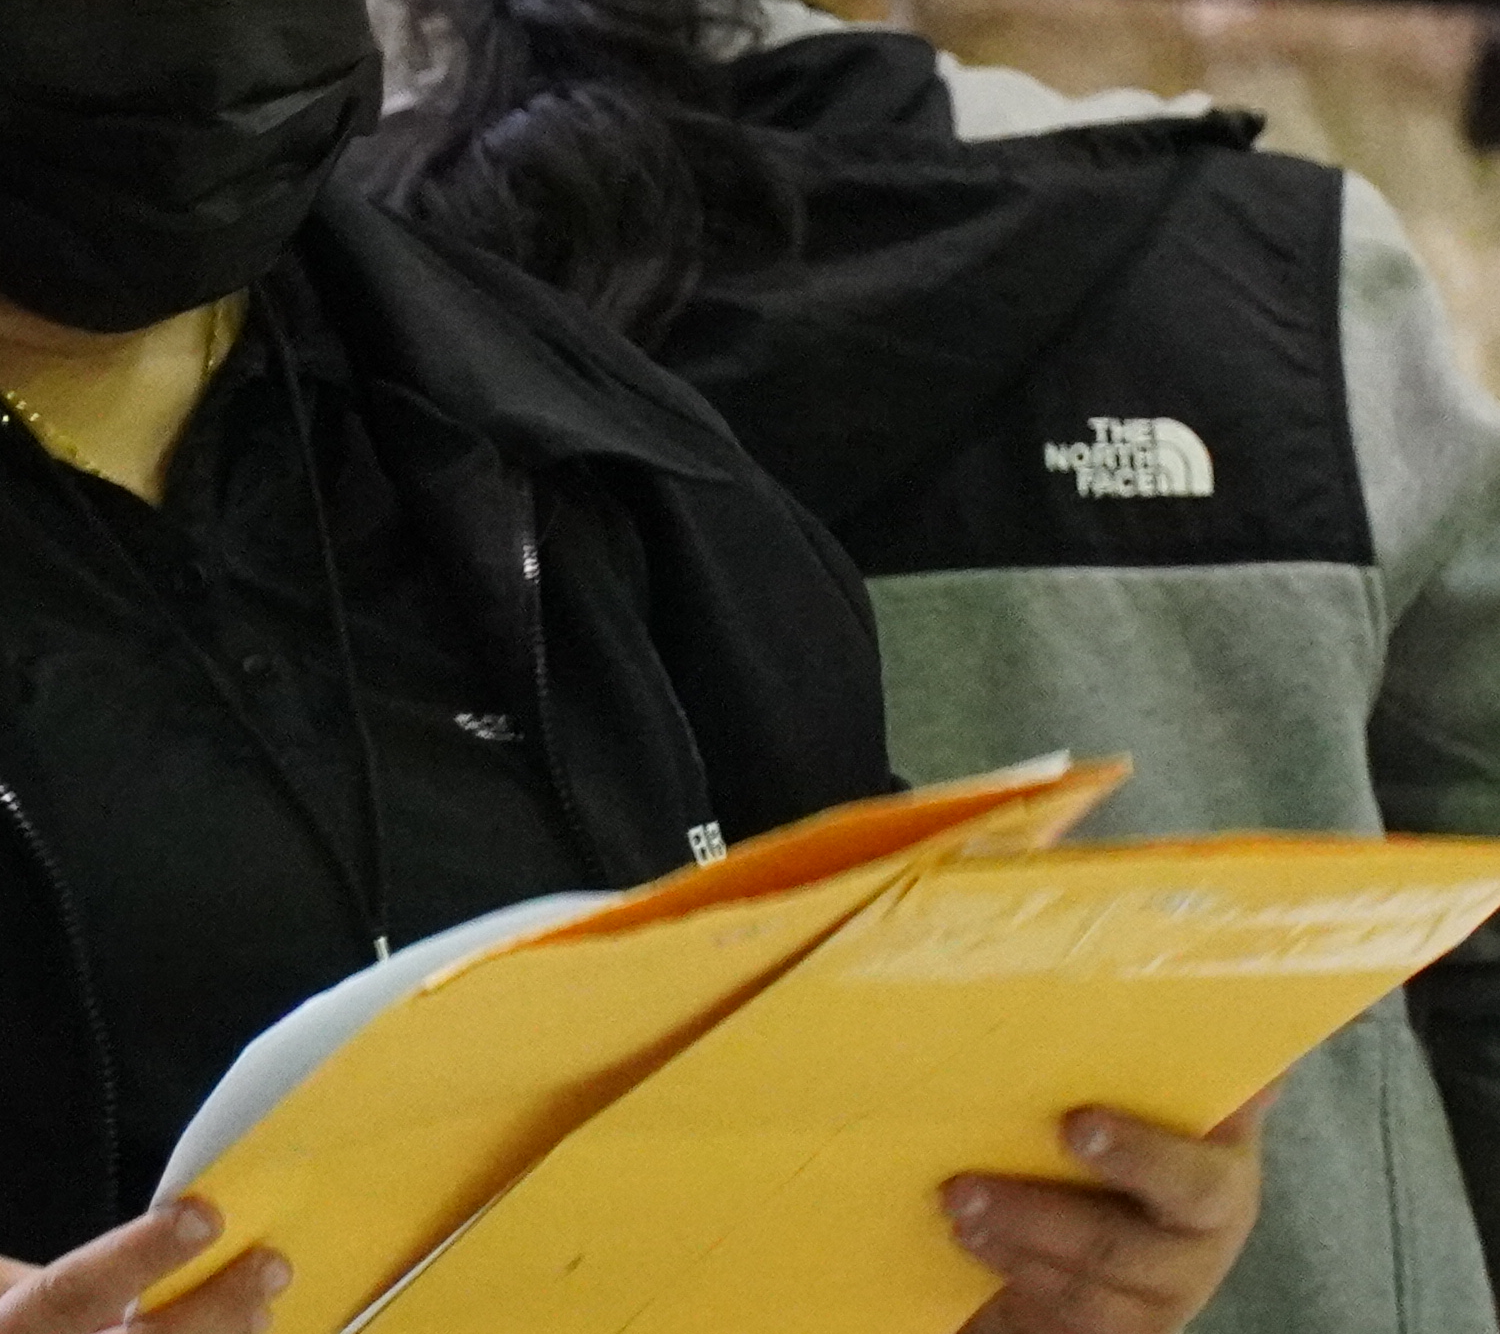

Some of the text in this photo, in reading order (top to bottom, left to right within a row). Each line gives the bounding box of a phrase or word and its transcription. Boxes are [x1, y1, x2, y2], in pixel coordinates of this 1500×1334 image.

[1087, 417, 1155, 442] THE
[1044, 441, 1156, 471] NORTH
[1076, 468, 1157, 498] FACE
